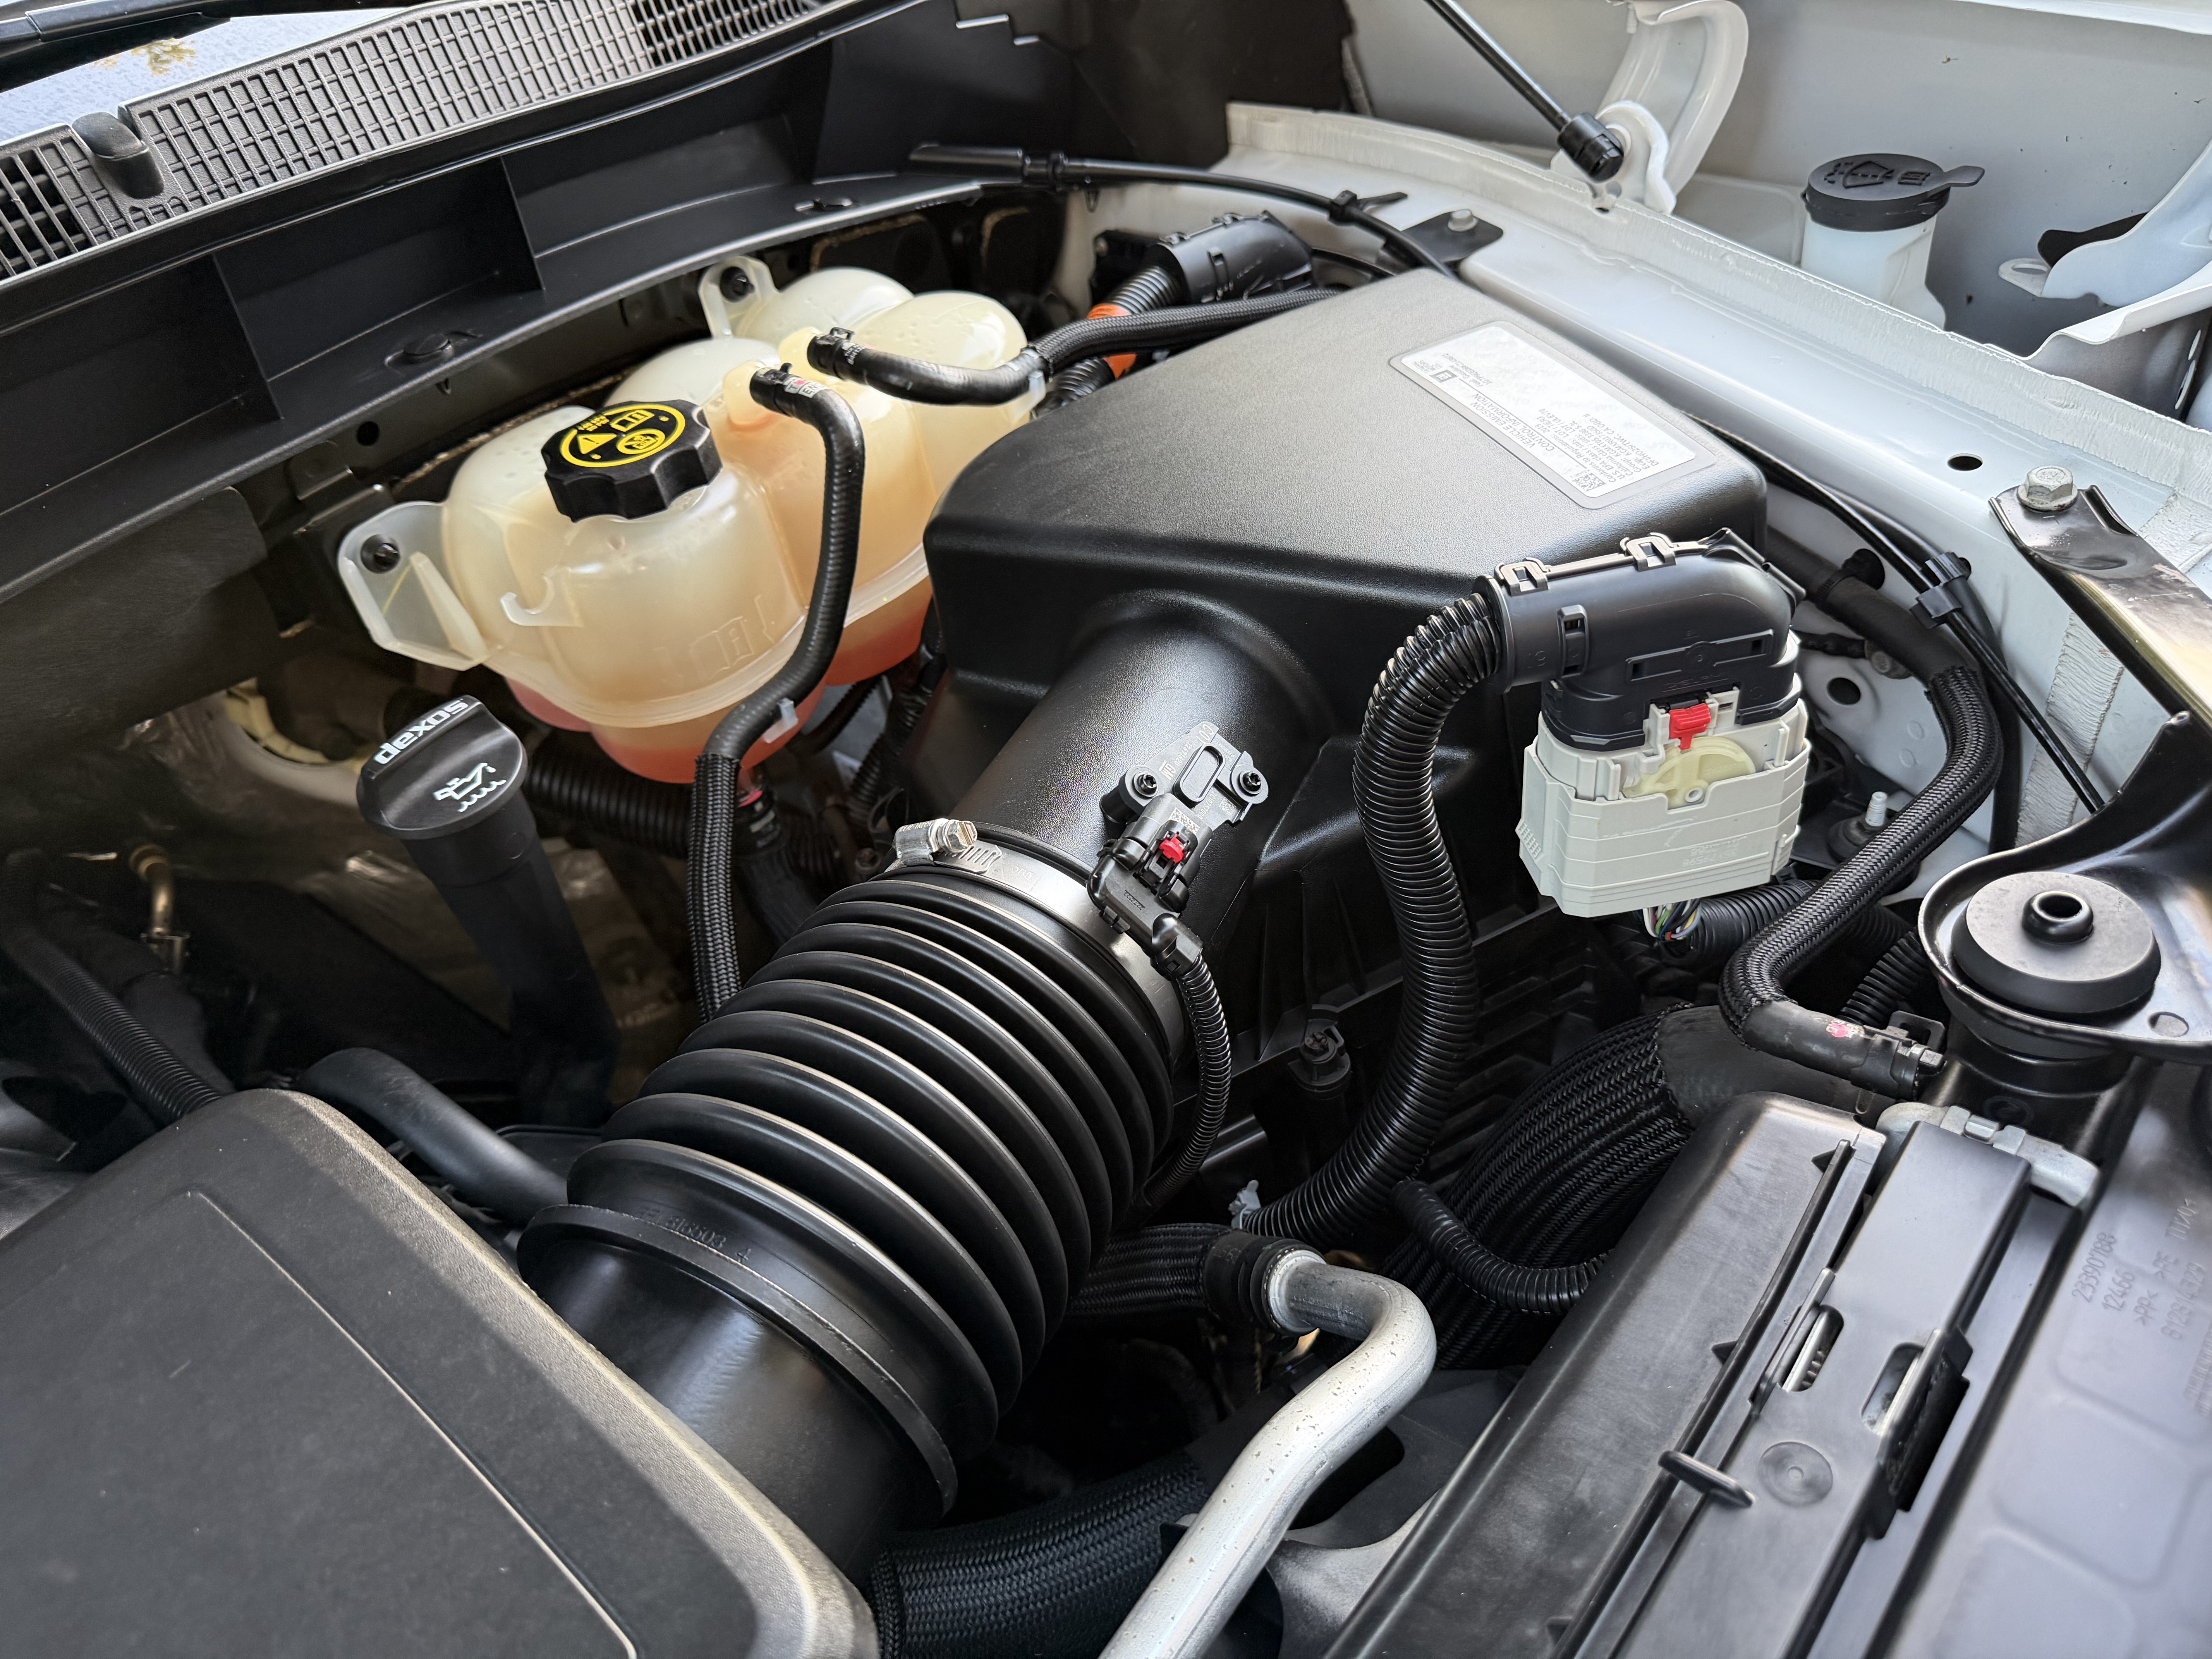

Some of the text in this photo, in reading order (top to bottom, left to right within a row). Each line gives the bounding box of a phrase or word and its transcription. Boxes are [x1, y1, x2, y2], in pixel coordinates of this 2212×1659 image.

[1471, 393, 1522, 426] INFORMATION
[1537, 408, 1562, 423] ULEV70
[1470, 402, 1538, 448] VEHICLE EMISSION
[1533, 423, 1551, 434] 2019
[1535, 416, 1556, 428] TIER3
[1560, 424, 1576, 433] LDT
[1567, 420, 1583, 429] 5.3L
[1586, 416, 1606, 428] OBD:
[1516, 425, 1557, 452] CONTROL
[1553, 428, 1570, 438] LDT
[1572, 433, 1591, 444] stds:
[1547, 433, 1587, 459] Regulations:
[1566, 438, 1585, 449] stds:
[1583, 450, 1603, 462] class
[1589, 445, 1609, 457] class
[1597, 460, 1615, 471] EPA
[1602, 455, 1636, 476] California
[1618, 457, 1645, 473] Group:
[1629, 456, 1652, 470] Evap:
[1585, 462, 1619, 483] Conforms
[1609, 469, 1627, 479] U.S.
[374, 700, 469, 764] dexos
[1196, 724, 1214, 744] C01
[1161, 763, 1176, 780] GM
[2102, 1269, 2135, 1312] 12466
